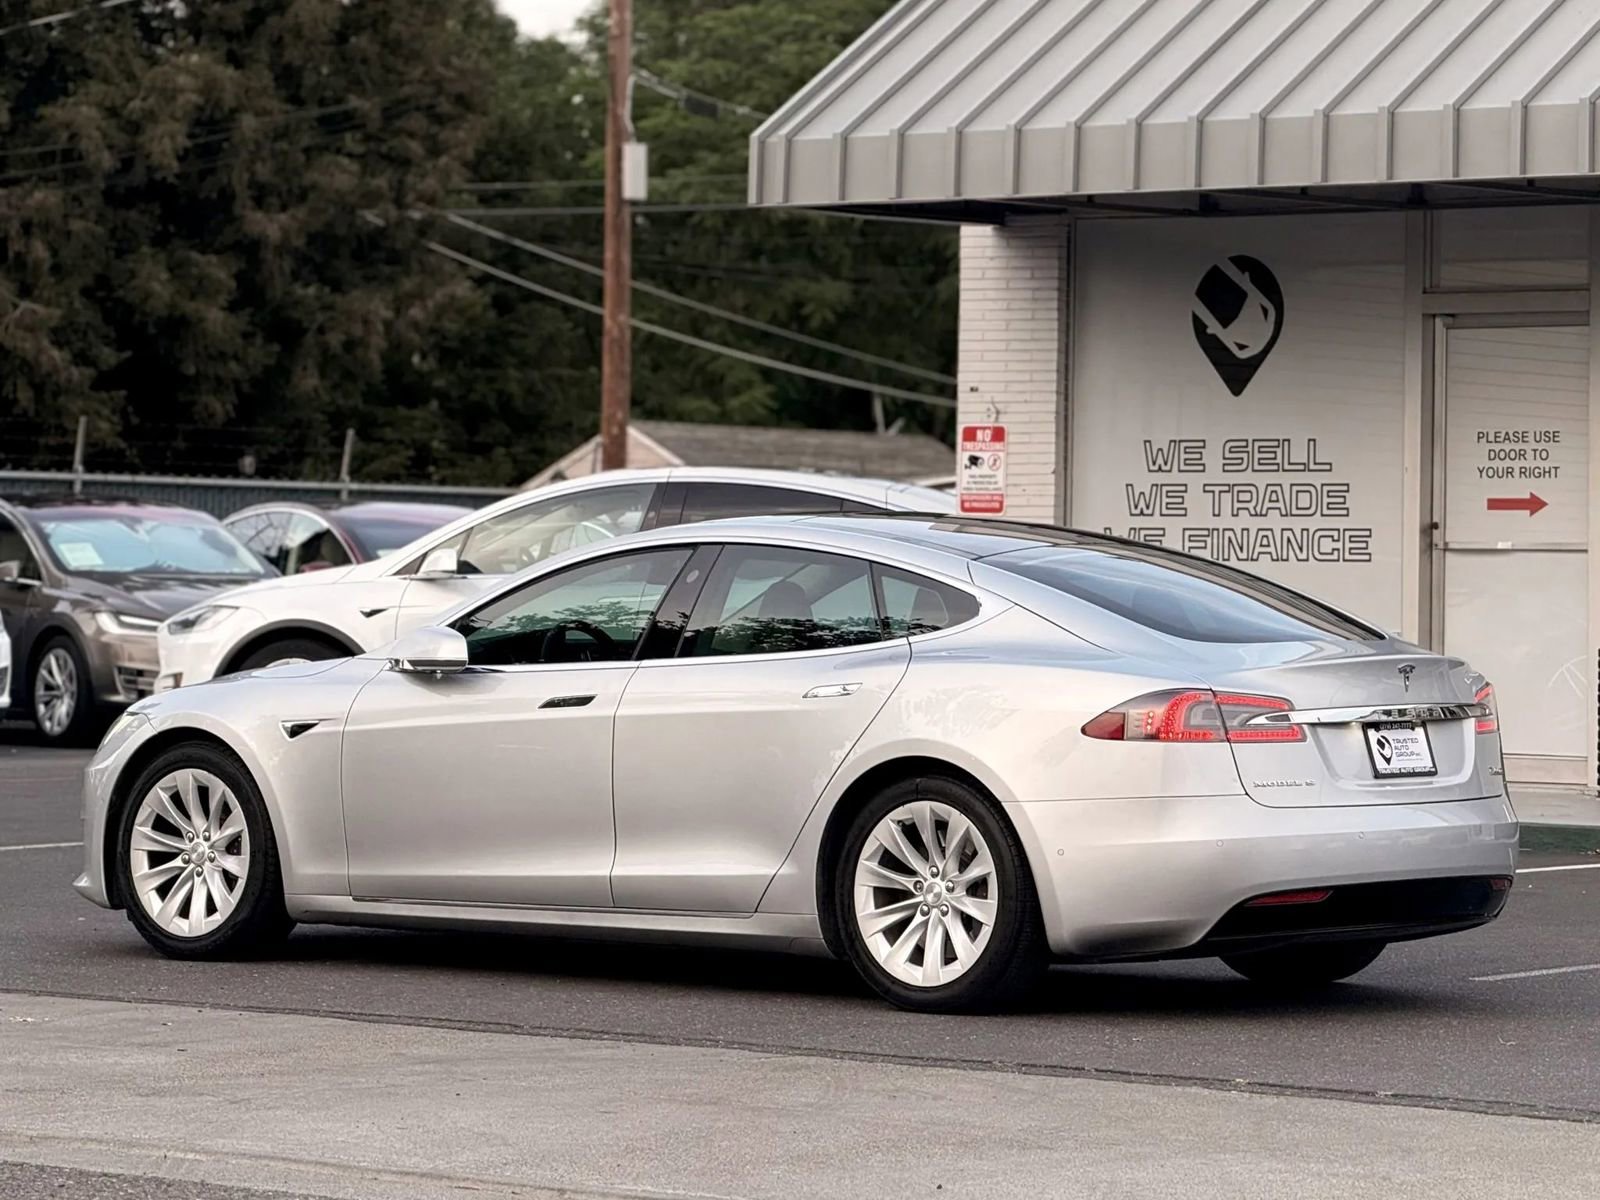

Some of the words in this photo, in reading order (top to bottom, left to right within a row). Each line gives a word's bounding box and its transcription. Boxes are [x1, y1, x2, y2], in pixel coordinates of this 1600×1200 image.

[976, 429, 992, 442] NO
[1476, 431, 1529, 444] PLEASE
[1533, 430, 1561, 443] USE
[1144, 439, 1206, 473] WE
[1222, 438, 1333, 473] SELL
[1487, 449, 1528, 462] DOOR
[1531, 449, 1550, 461] TO
[1476, 466, 1515, 479] YOUR
[1519, 466, 1561, 479] RIGHT
[1126, 483, 1188, 517] WE
[1203, 483, 1350, 517] TRADE
[1182, 528, 1372, 562] FINANCE
[1253, 779, 1303, 788] MODEL
[1305, 779, 1316, 787] S
